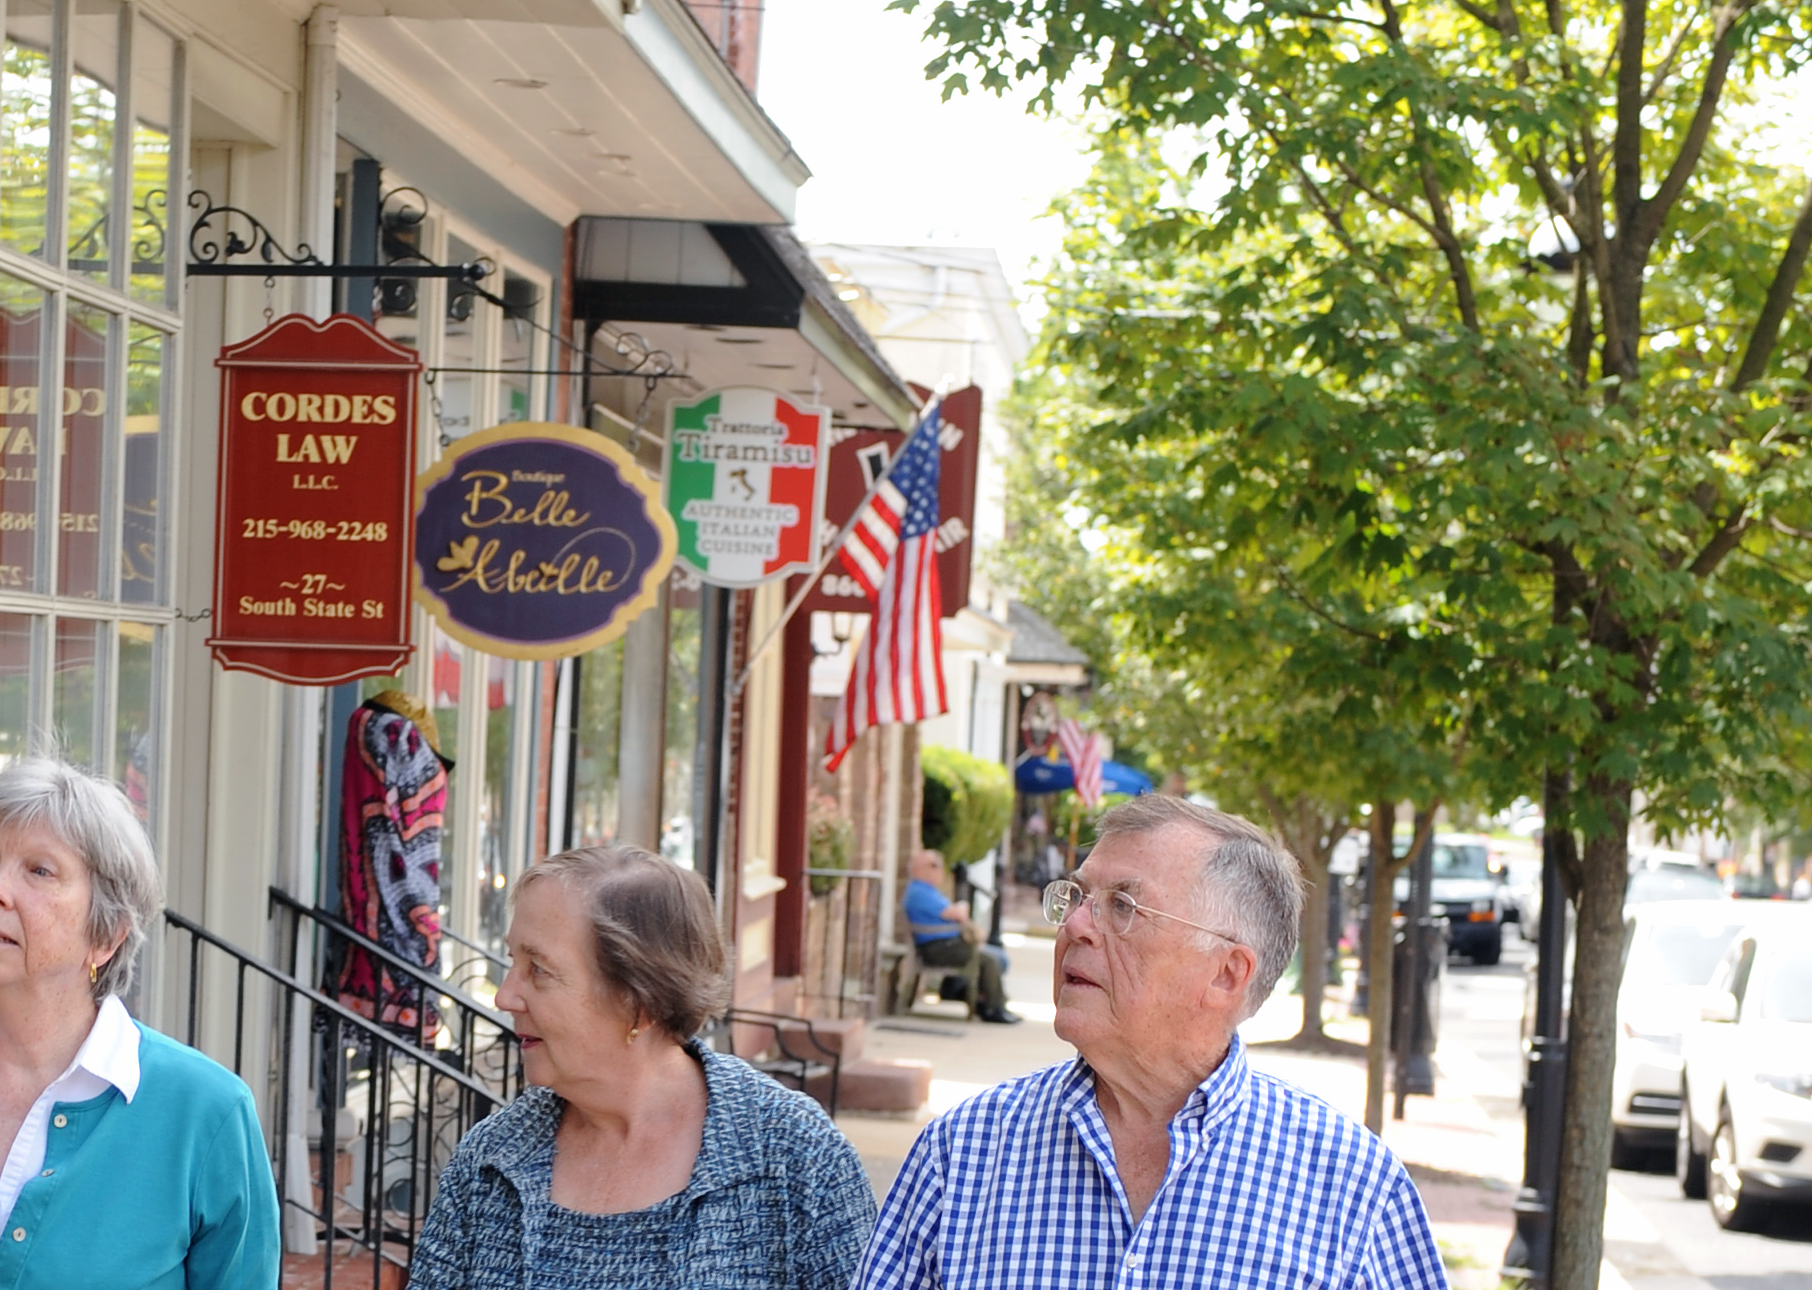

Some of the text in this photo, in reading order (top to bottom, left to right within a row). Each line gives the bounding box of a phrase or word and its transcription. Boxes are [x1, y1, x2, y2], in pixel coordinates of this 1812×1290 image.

[241, 391, 397, 425] CORDES
[709, 418, 785, 436] Trattoria
[276, 433, 358, 464] LAW
[679, 432, 813, 464] Tiramisu
[293, 474, 339, 490] L.L.C.
[512, 469, 566, 488] Boutique
[460, 470, 590, 528] Belle
[687, 504, 795, 521] AUTHENTIC
[242, 518, 388, 542] 215-968-2248
[701, 522, 775, 537] ITALIAN
[700, 539, 774, 555] CUISINE
[439, 538, 616, 594] Abeille
[239, 595, 384, 619] South State St
